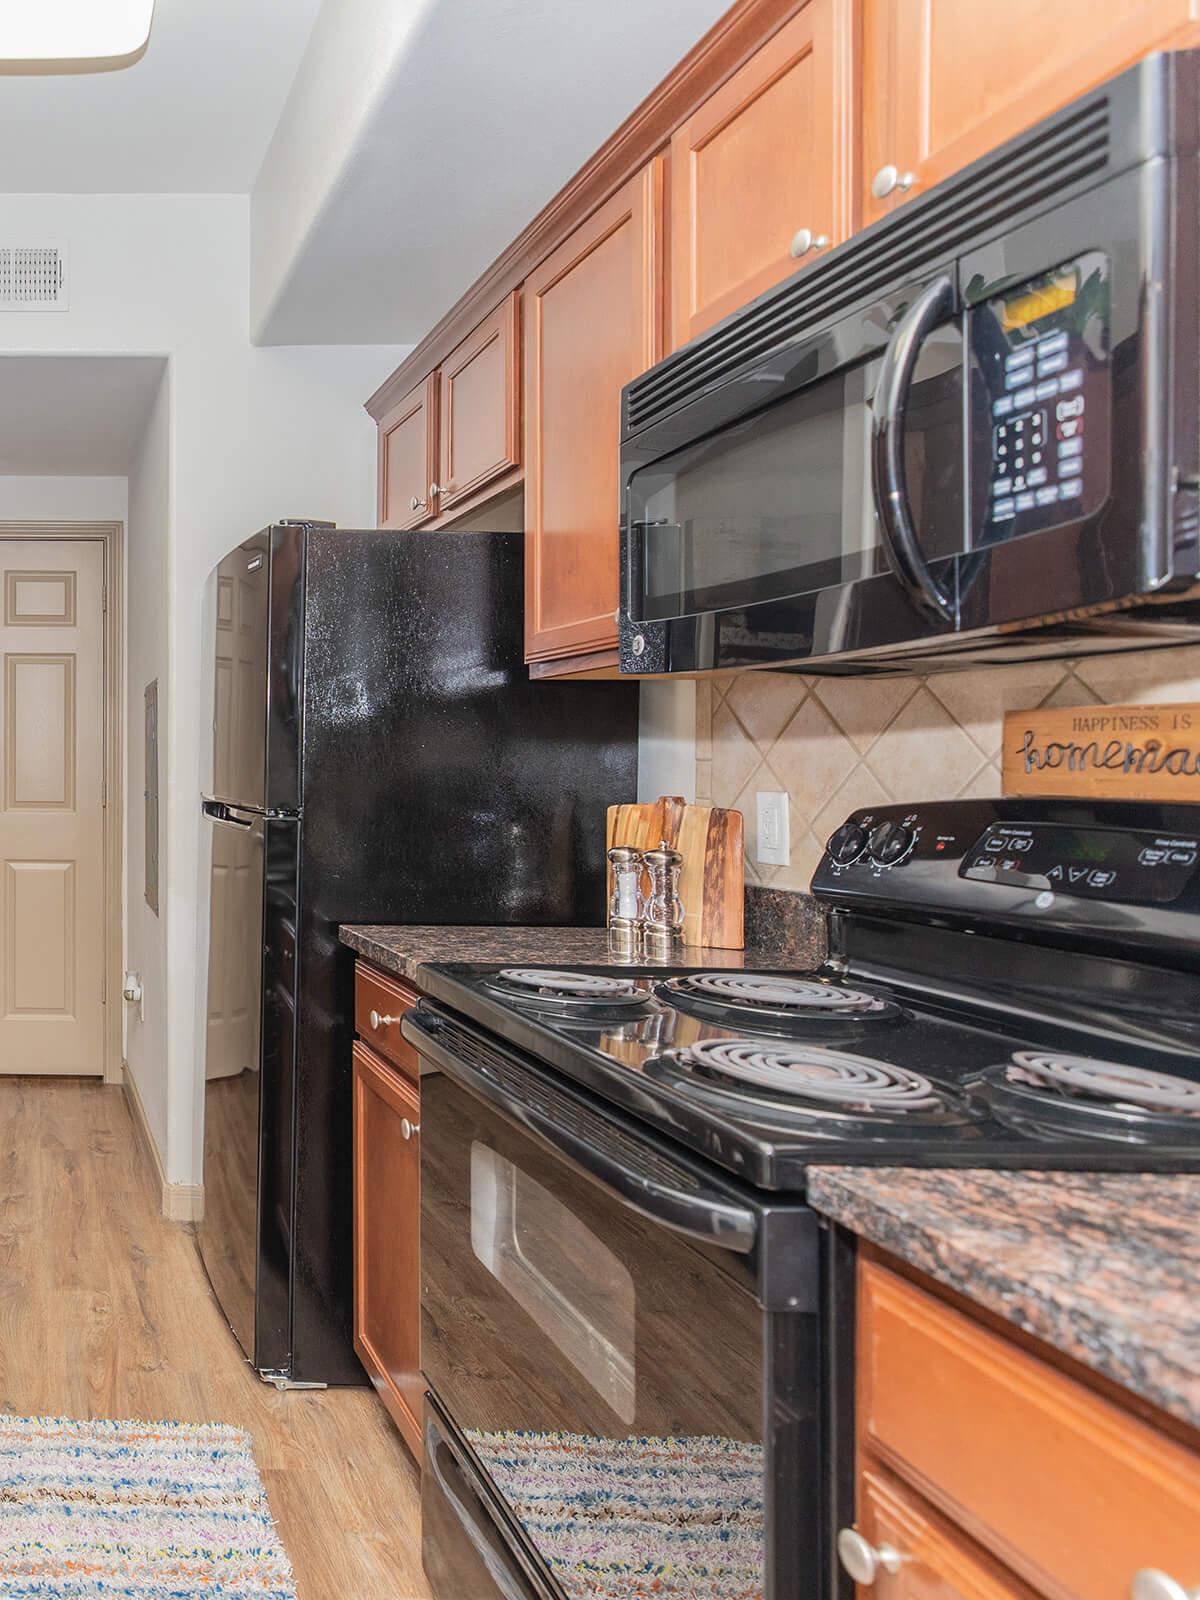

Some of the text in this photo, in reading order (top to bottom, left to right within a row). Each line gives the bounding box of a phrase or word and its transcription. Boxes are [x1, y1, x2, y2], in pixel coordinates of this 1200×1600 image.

[1072, 713, 1192, 732] HAPPINESS IS
[1015, 730, 1200, 776] homema
